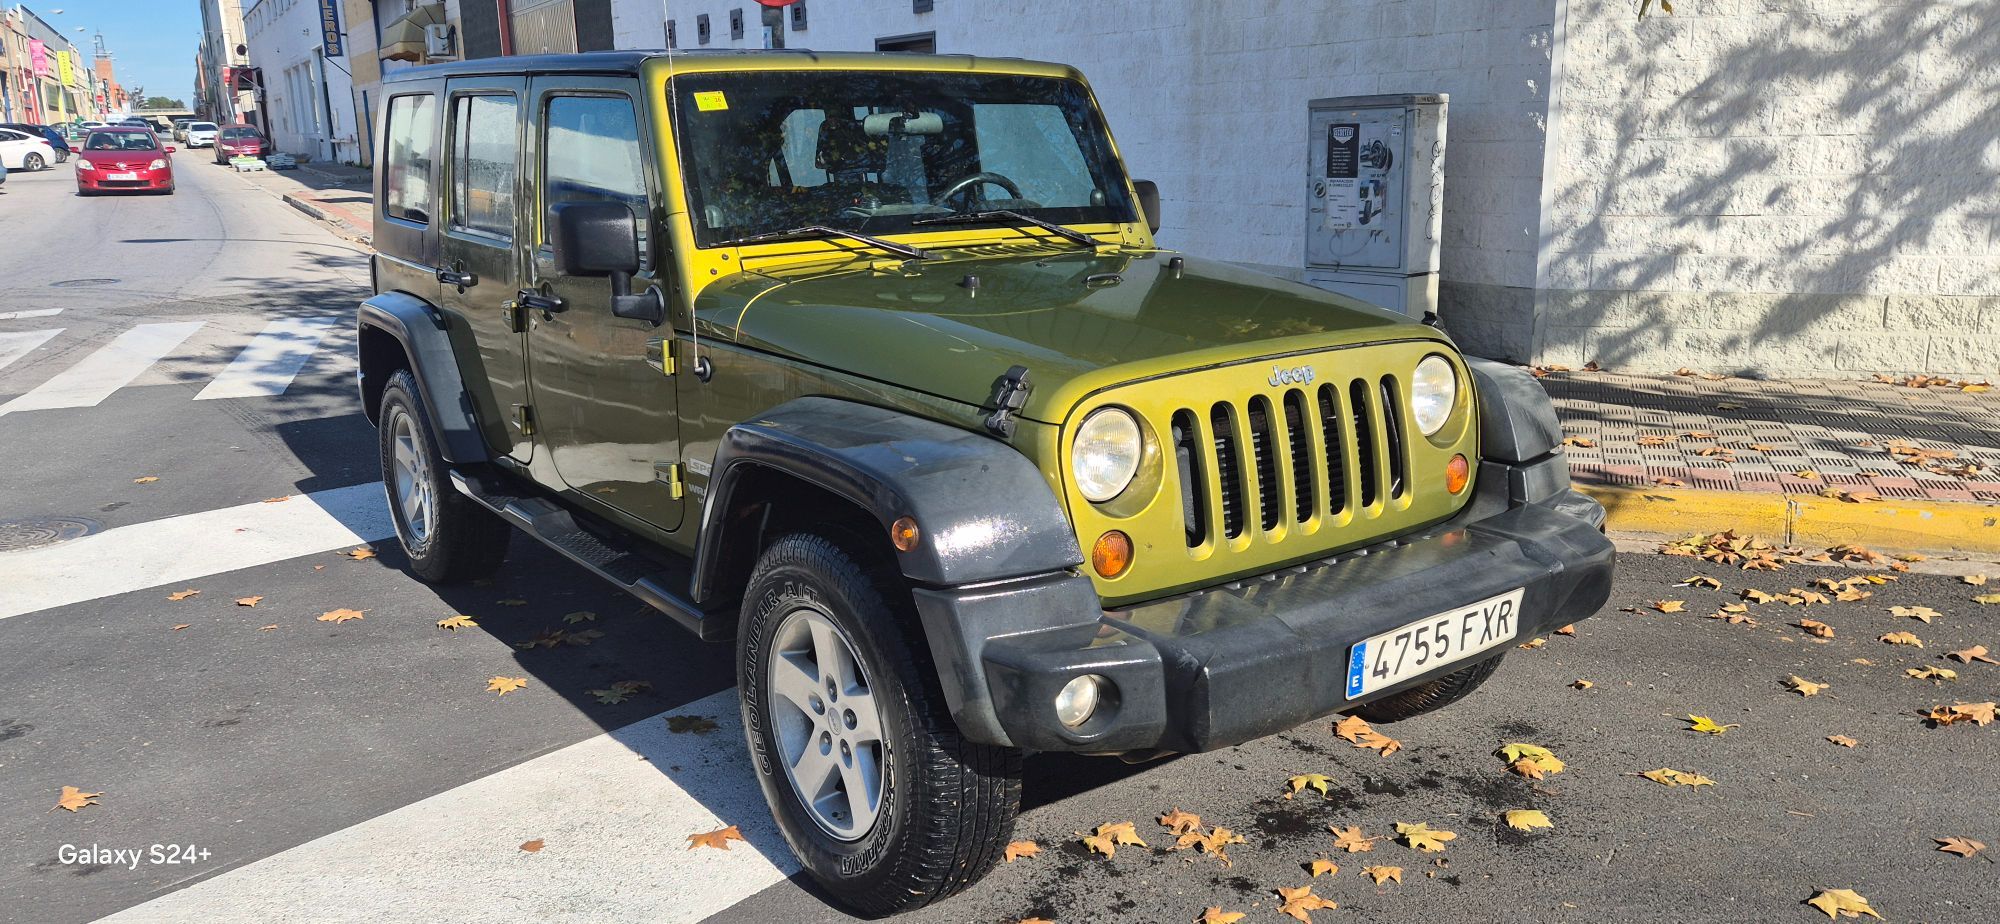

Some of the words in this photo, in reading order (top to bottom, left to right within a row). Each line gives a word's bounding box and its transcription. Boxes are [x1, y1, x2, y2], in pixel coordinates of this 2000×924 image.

[1268, 364, 1315, 387] Jeep
[1372, 619, 1450, 680] 4755
[1460, 599, 1513, 651] FXR
[744, 589, 780, 776] GEOLANDAR
[1351, 674, 1360, 688] E
